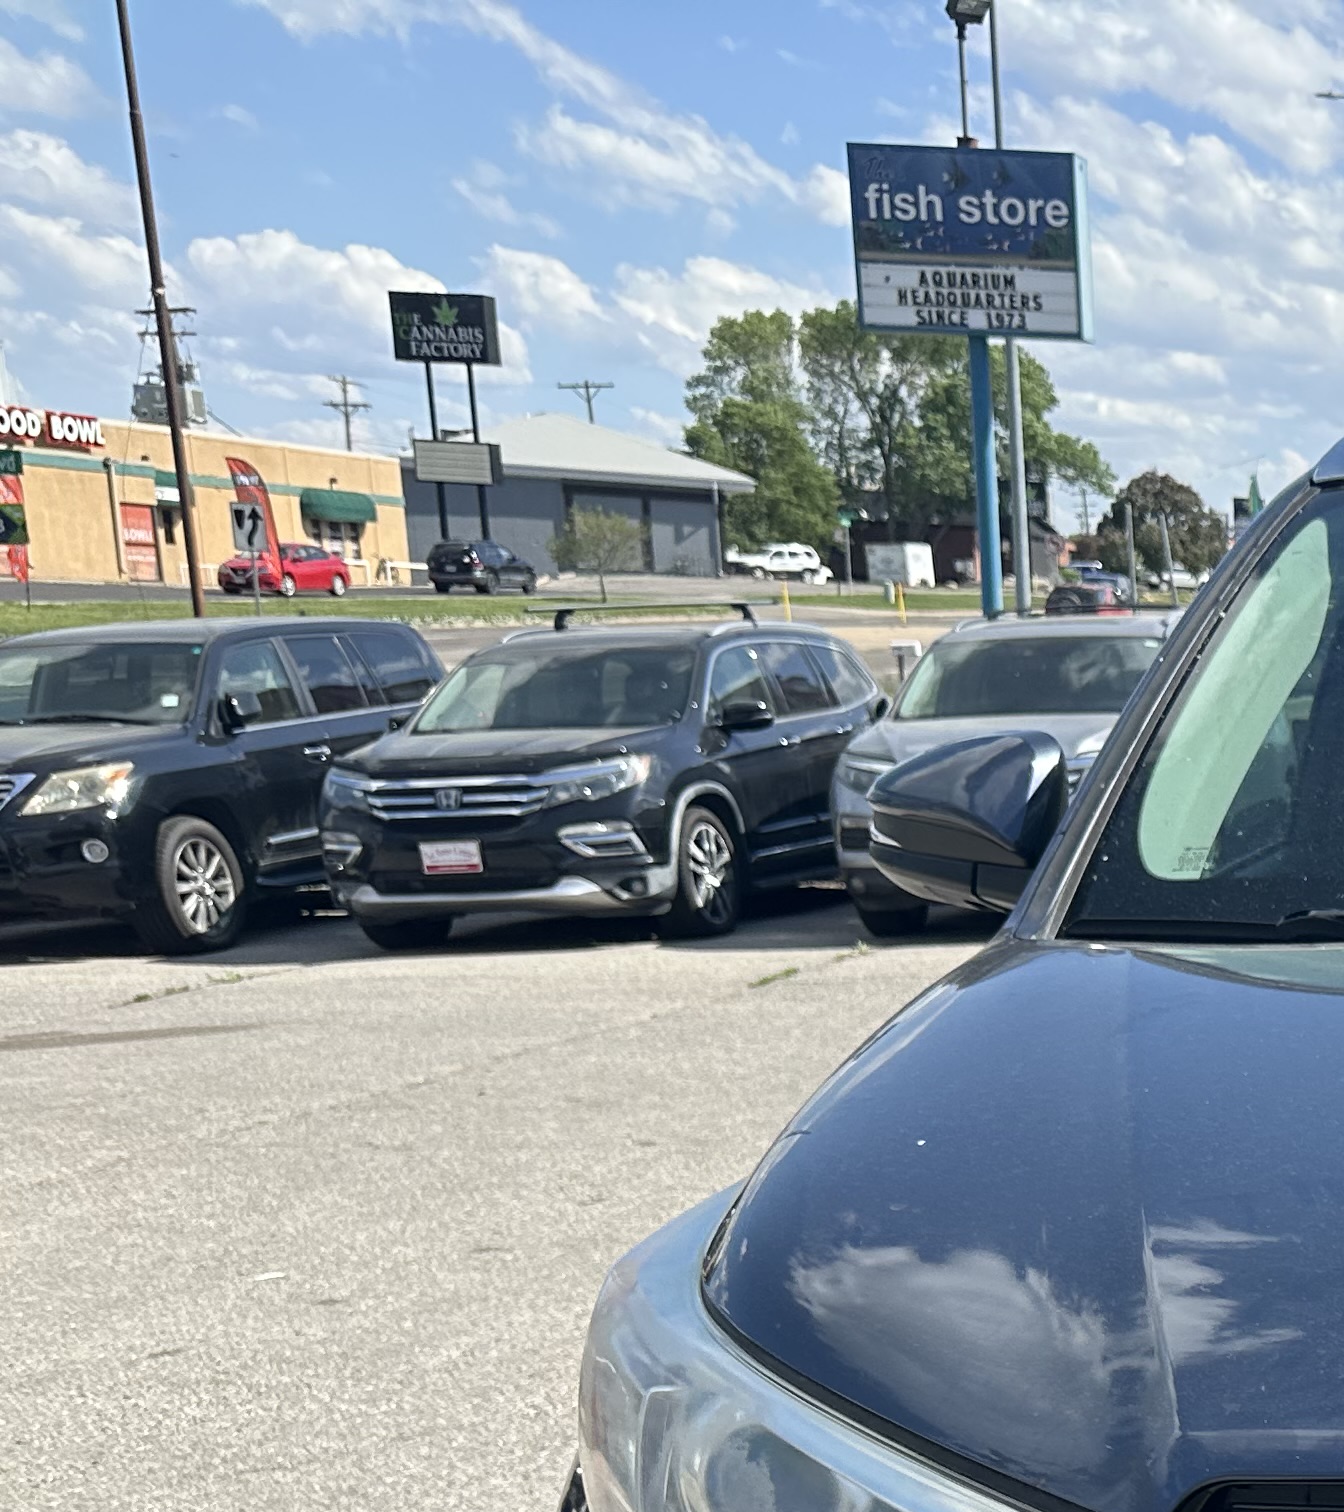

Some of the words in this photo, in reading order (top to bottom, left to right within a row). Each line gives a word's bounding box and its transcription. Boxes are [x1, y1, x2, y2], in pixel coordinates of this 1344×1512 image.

[864, 182, 944, 223] fish
[958, 189, 1070, 228] store
[919, 270, 1016, 290] AQUARIUM
[897, 287, 1043, 312] HEADQUARTERS
[915, 310, 968, 328] SINCE
[986, 312, 1028, 331] 1973
[398, 325, 484, 344] CANNABIS
[410, 341, 483, 358] FACTORY
[50, 415, 106, 445] BOWL
